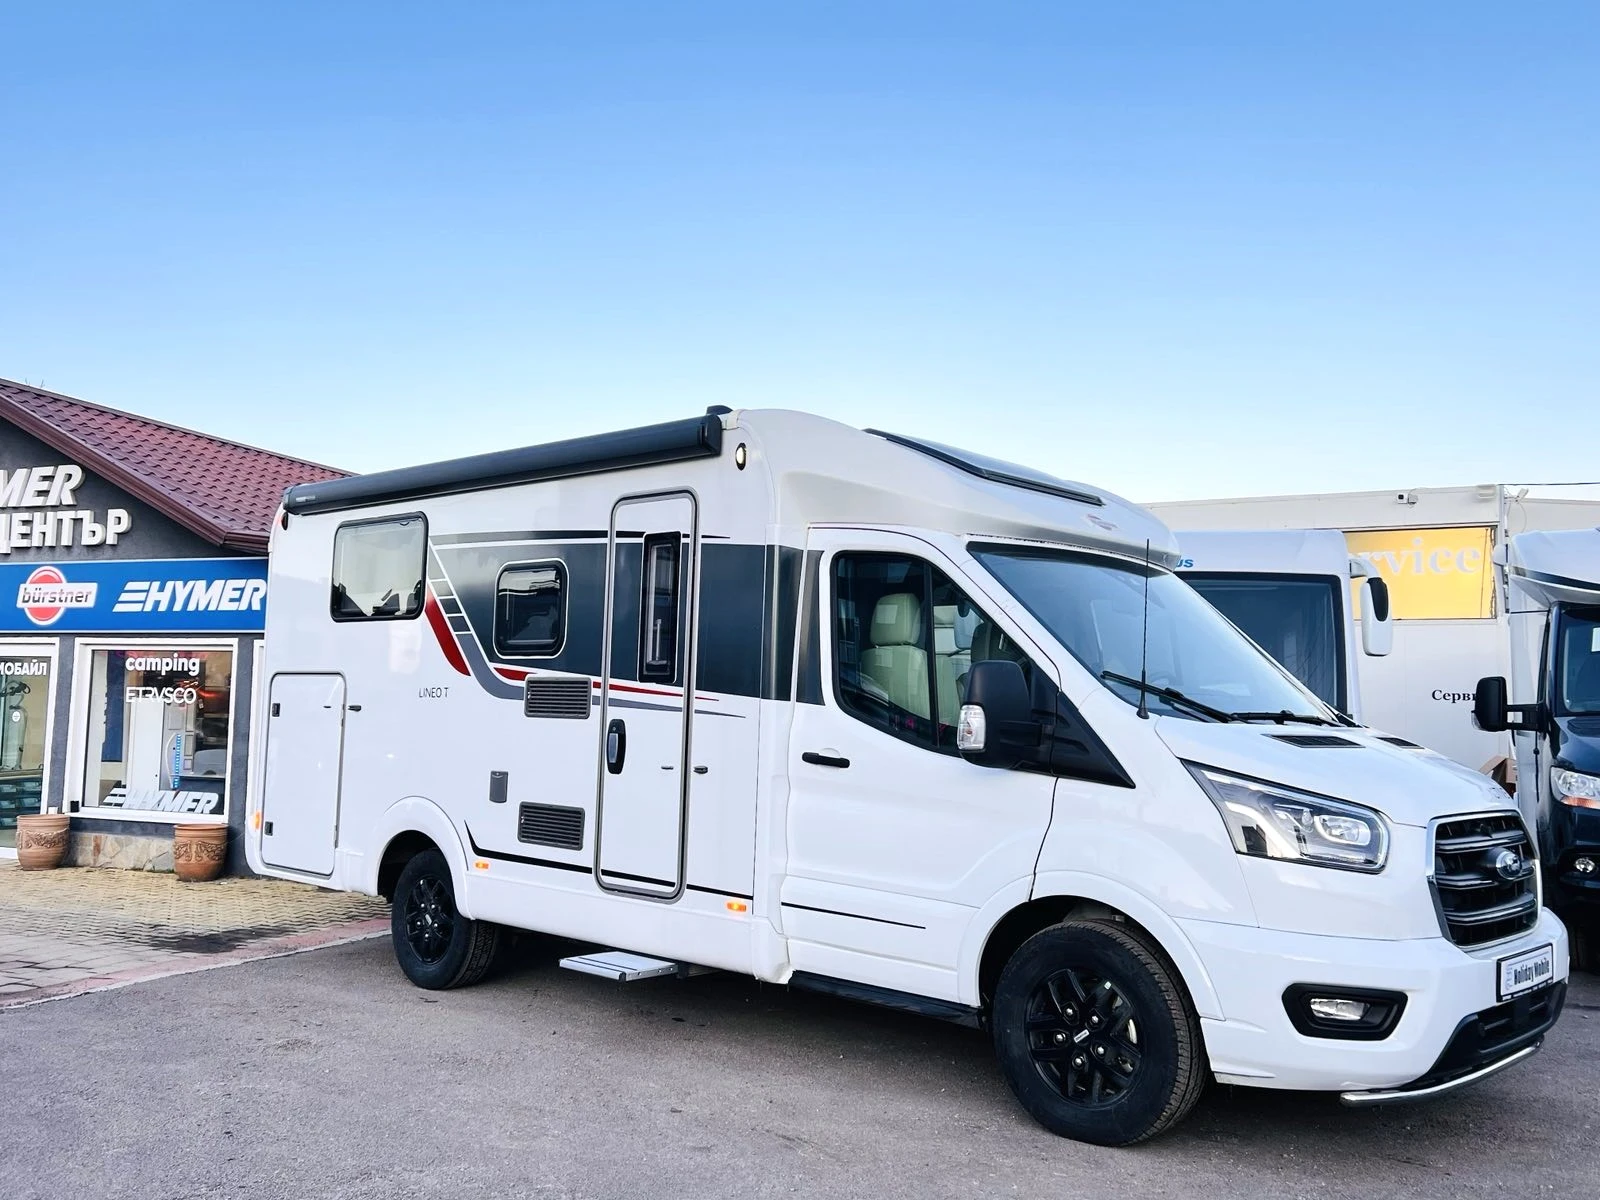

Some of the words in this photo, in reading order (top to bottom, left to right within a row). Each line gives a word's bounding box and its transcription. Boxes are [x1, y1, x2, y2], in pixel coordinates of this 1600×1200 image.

[22, 587, 92, 604] bürstner
[142, 578, 267, 612] HYMER
[125, 652, 200, 677] camping
[418, 687, 442, 698] LINEO
[444, 687, 449, 698] T
[1431, 689, 1477, 704] Серв
